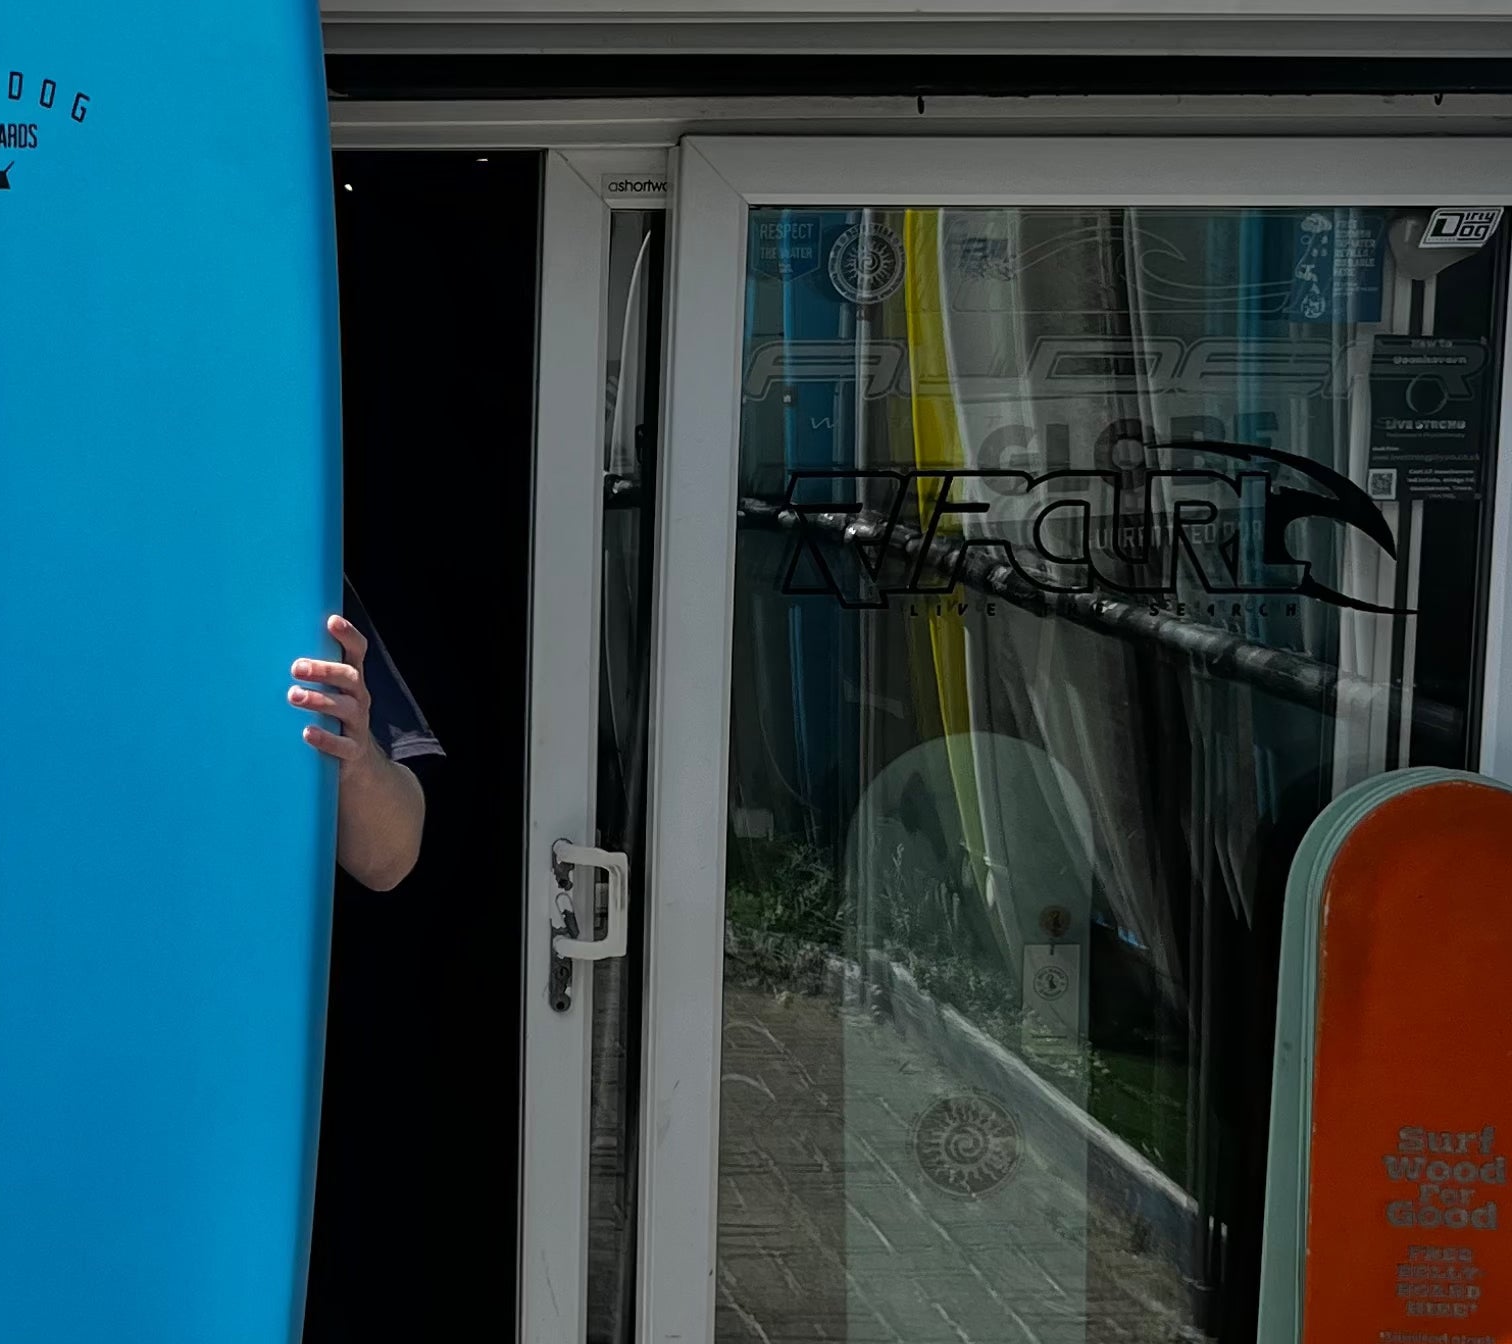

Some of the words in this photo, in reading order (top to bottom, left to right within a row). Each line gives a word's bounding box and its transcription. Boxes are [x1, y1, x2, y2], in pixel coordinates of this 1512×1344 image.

[759, 223, 815, 239] RESPECT
[909, 602, 997, 617] LIVE
[1398, 1123, 1496, 1154] Surf
[1381, 1154, 1508, 1184] Wood
[1385, 1199, 1498, 1230] Good
